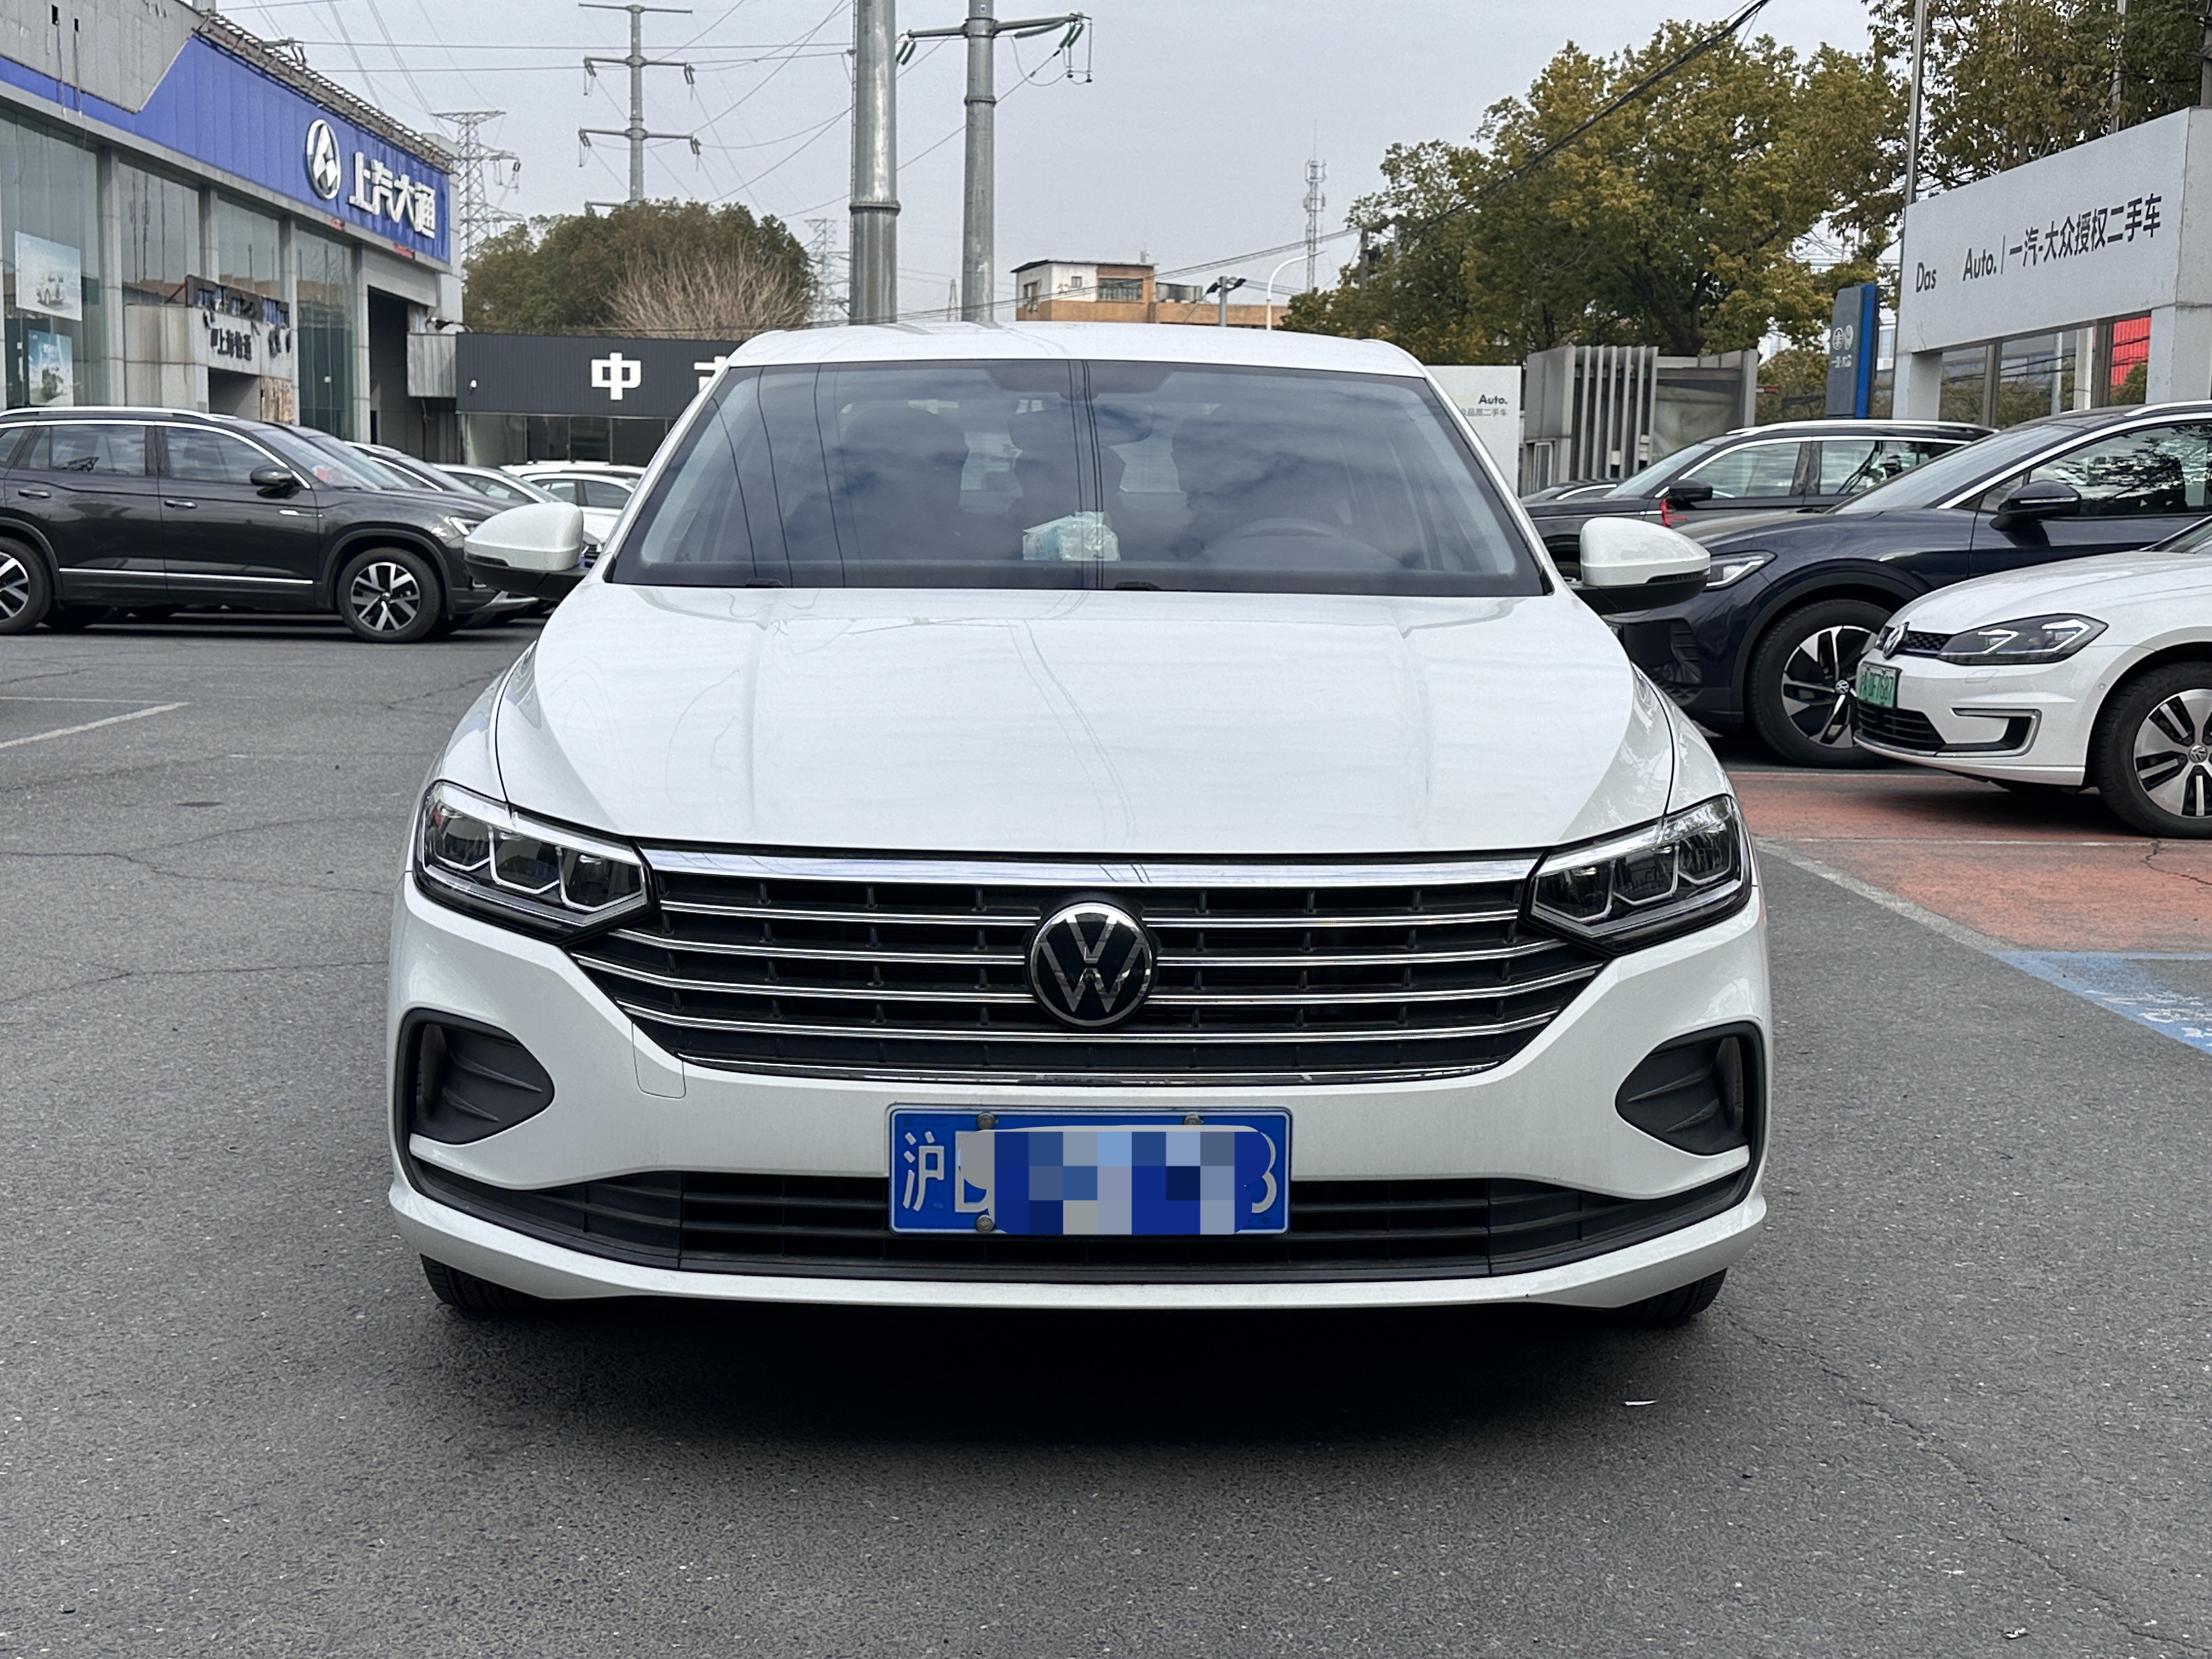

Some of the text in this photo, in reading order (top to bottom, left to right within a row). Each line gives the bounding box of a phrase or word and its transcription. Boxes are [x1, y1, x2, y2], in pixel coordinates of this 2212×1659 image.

[349, 152, 436, 239] 上汽大通
[1916, 262, 1937, 292] Das
[1962, 248, 1996, 281] Auto.
[1479, 394, 1508, 404] Auto.
